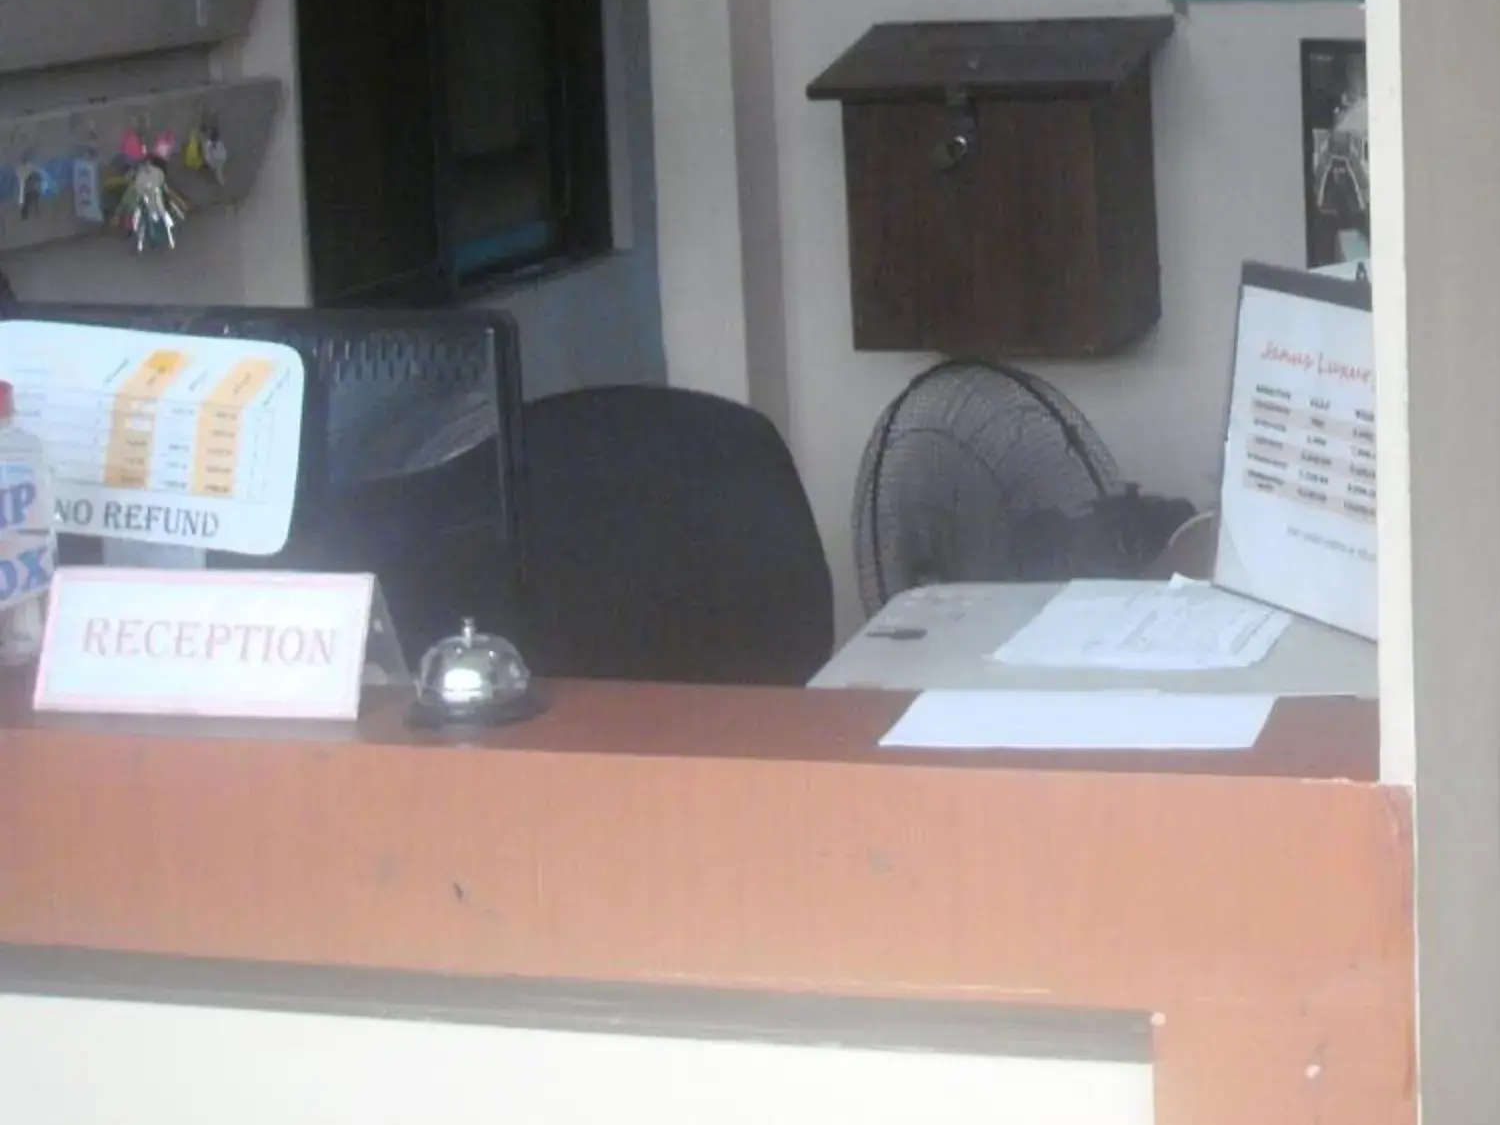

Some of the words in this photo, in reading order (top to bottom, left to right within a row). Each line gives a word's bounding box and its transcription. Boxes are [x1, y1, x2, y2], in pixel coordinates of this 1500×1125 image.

[55, 497, 94, 526] NO
[103, 502, 219, 538] REFUND
[0, 545, 48, 601] OX
[82, 617, 336, 666] RECEPTION
